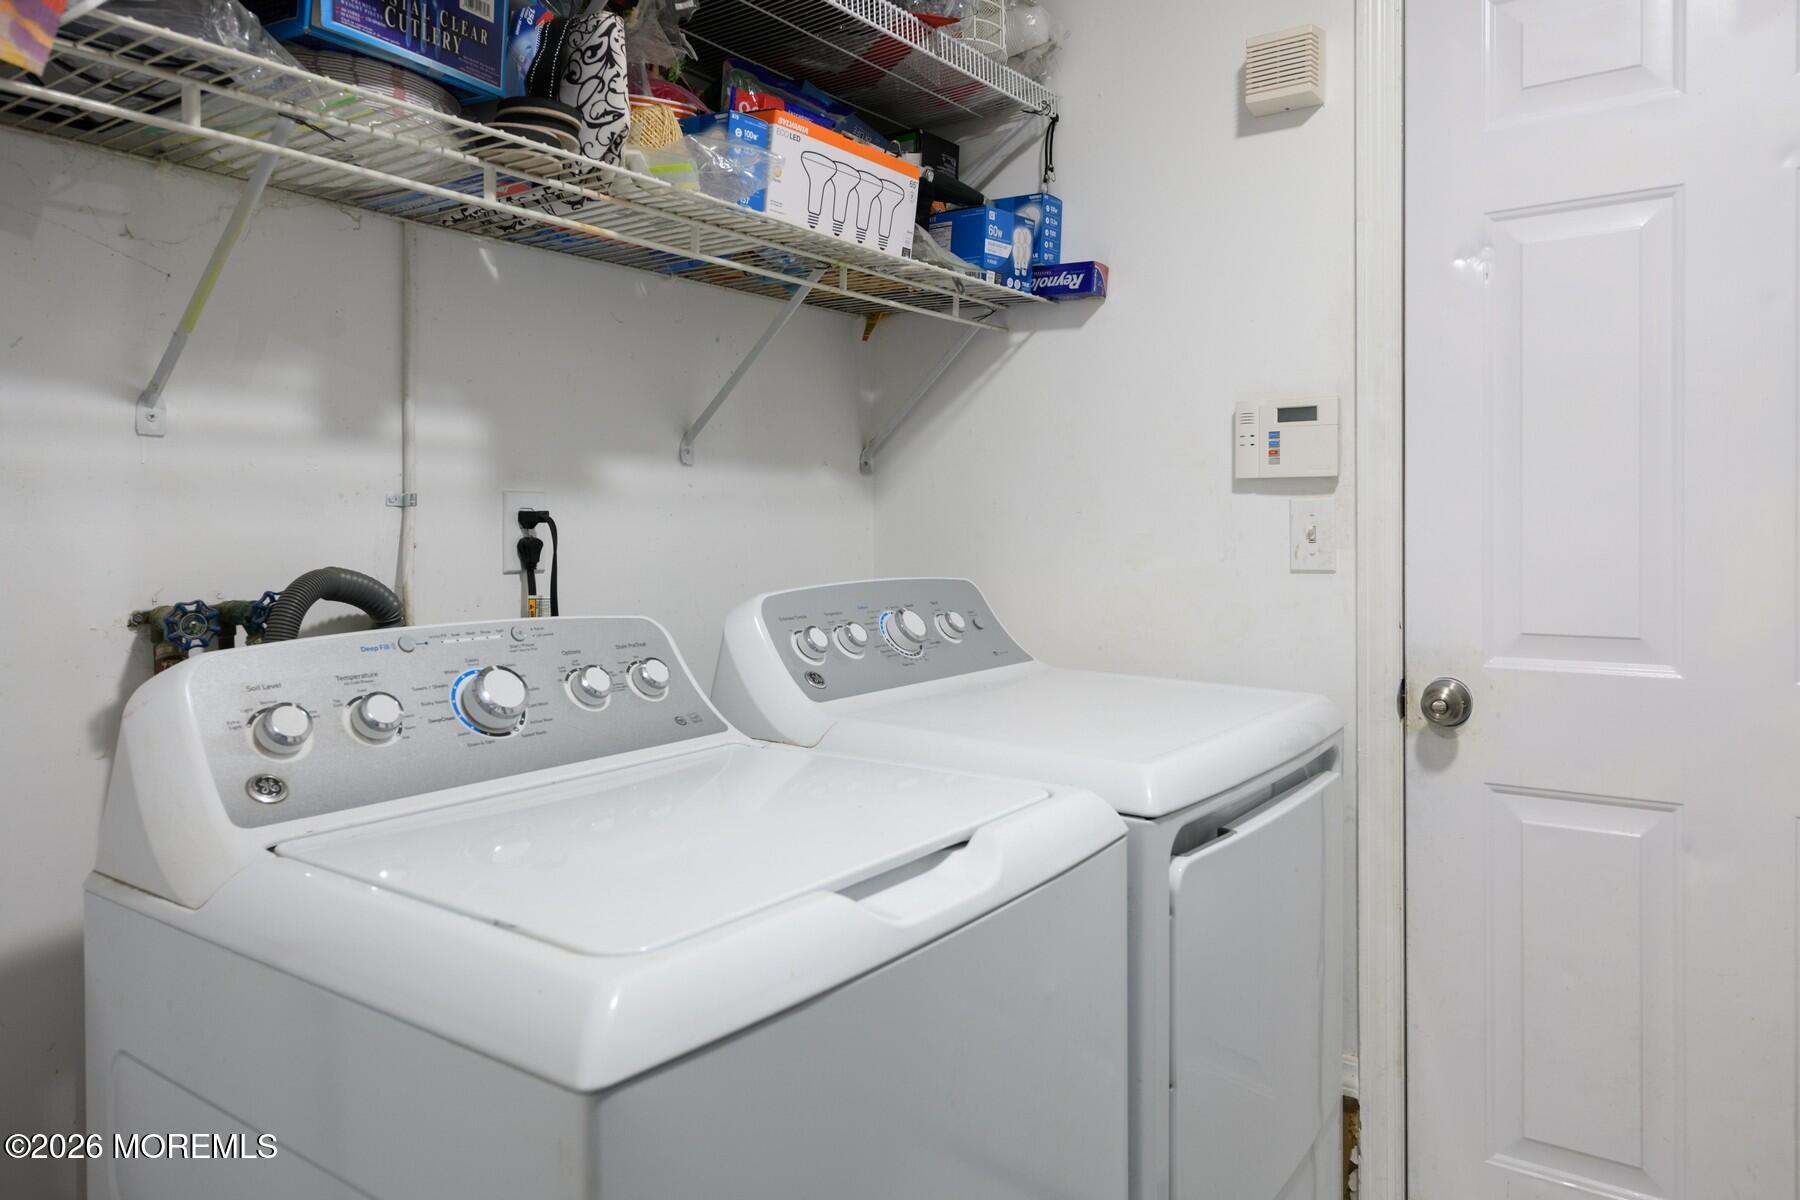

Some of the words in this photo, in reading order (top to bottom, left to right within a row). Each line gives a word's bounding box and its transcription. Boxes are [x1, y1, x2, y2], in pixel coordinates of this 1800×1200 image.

[384, 6, 462, 55] CUTLERY
[439, 10, 488, 45] CLEAR
[777, 117, 809, 135] SYLVANIA
[776, 127, 789, 138] ECO
[789, 131, 801, 142] LED
[360, 645, 379, 653] Deep
[335, 672, 378, 681] Temperature
[245, 684, 260, 692] Soil
[262, 683, 282, 691] Level
